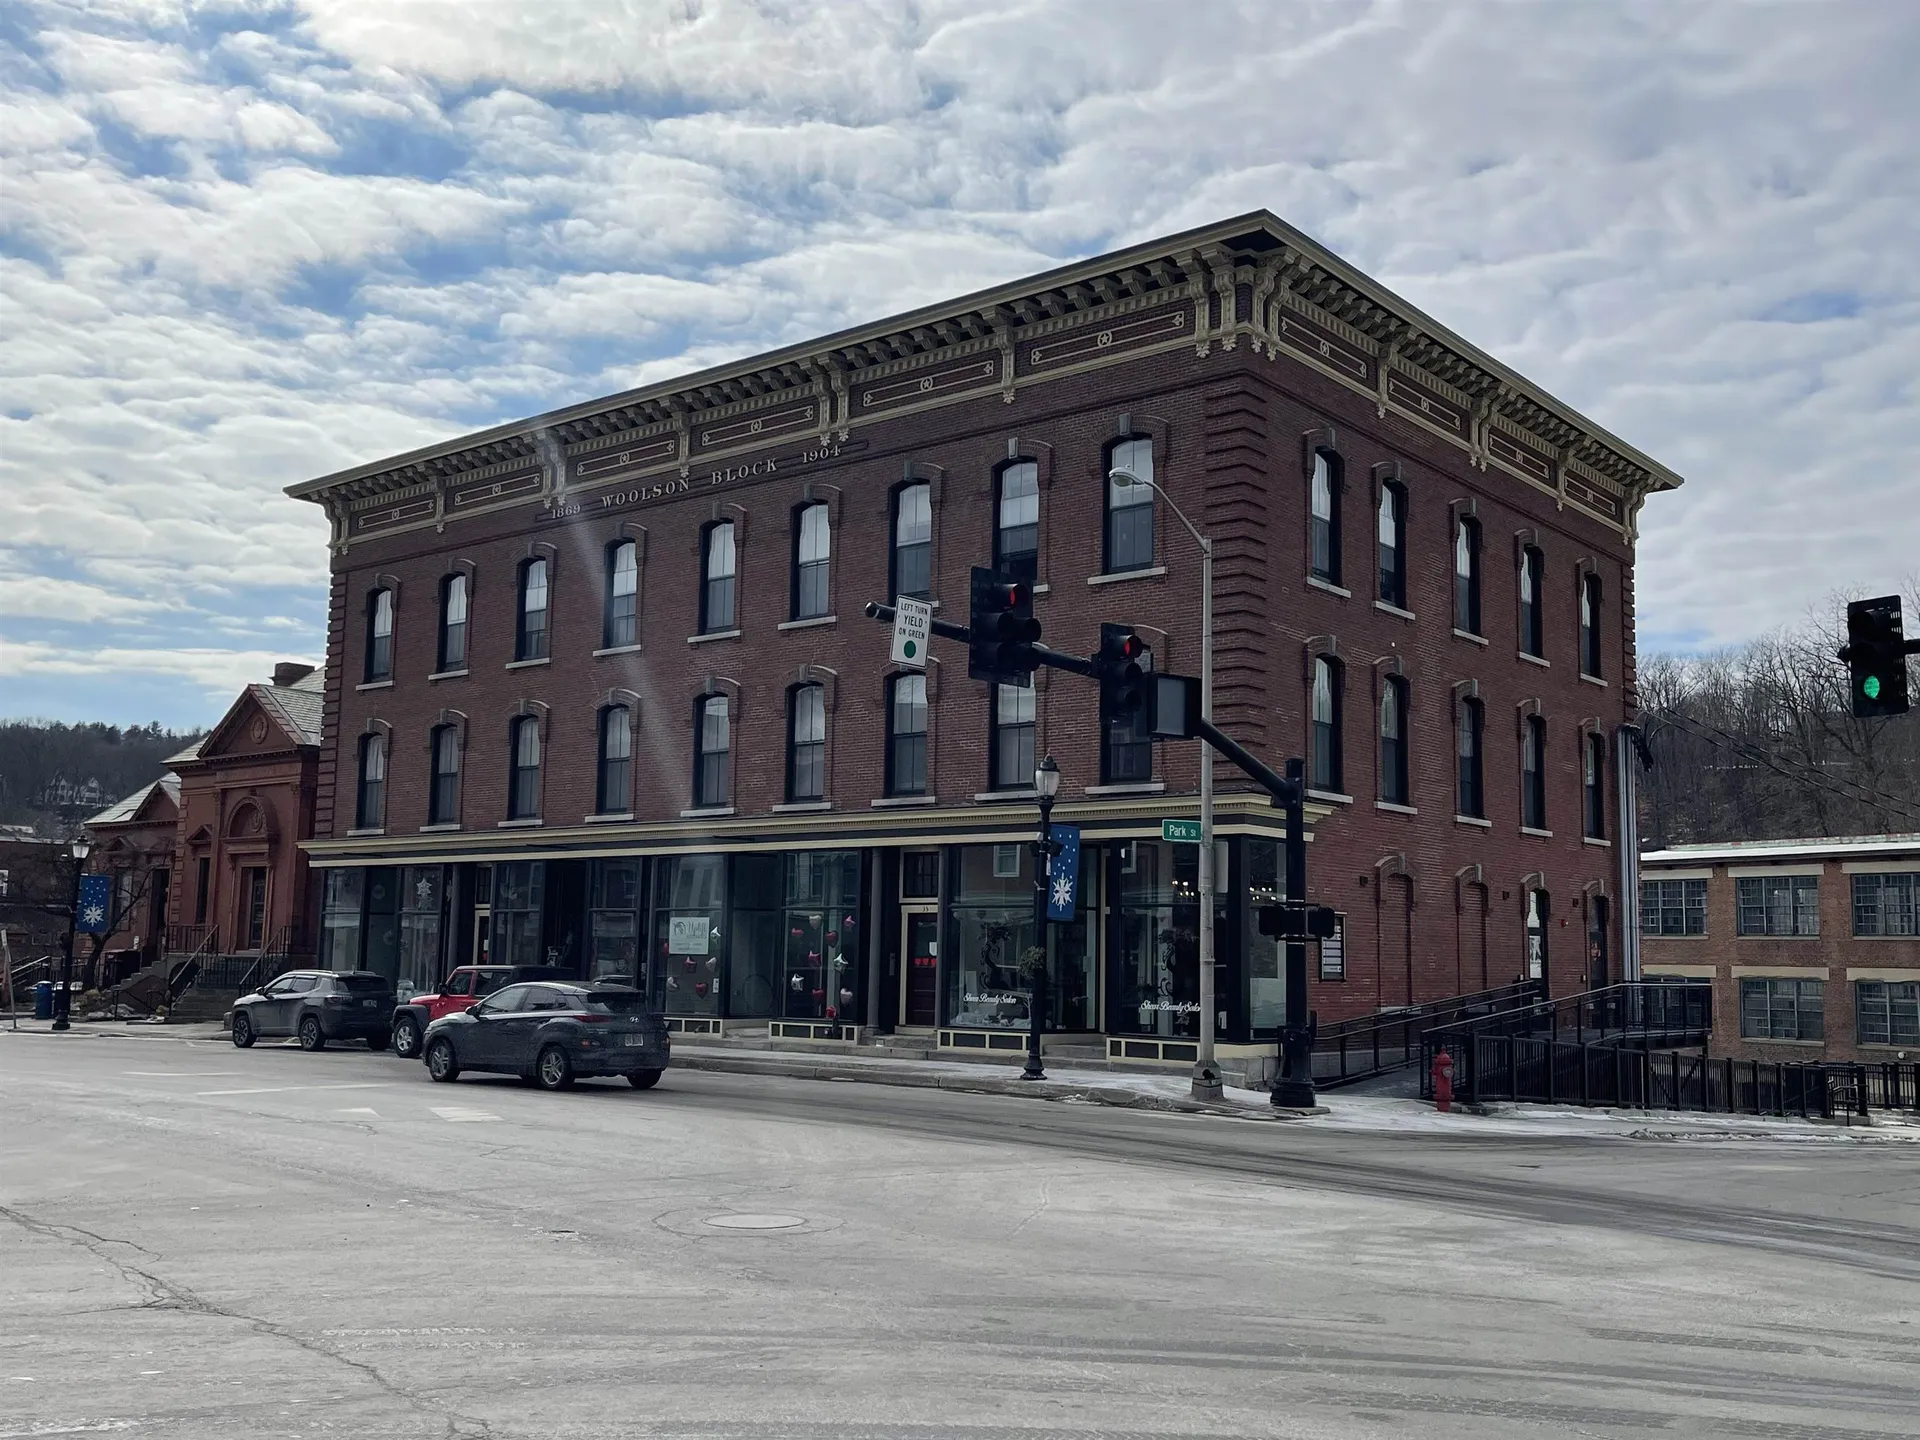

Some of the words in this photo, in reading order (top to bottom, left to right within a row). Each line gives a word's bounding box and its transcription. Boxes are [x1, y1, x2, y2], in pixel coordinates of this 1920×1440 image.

[552, 504, 581, 519] 1869
[602, 478, 689, 508] WOOLSON
[711, 458, 777, 485] BLOCK
[802, 445, 841, 464] 1904
[901, 603, 914, 611] LEFT
[915, 606, 928, 615] TURN
[904, 614, 924, 628] YIELD
[908, 630, 925, 639] GREEN
[1169, 825, 1187, 837] Park
[1000, 993, 1017, 1004] Salon
[1159, 1000, 1184, 1014] Beauty
[1184, 1001, 1200, 1012] Salo
